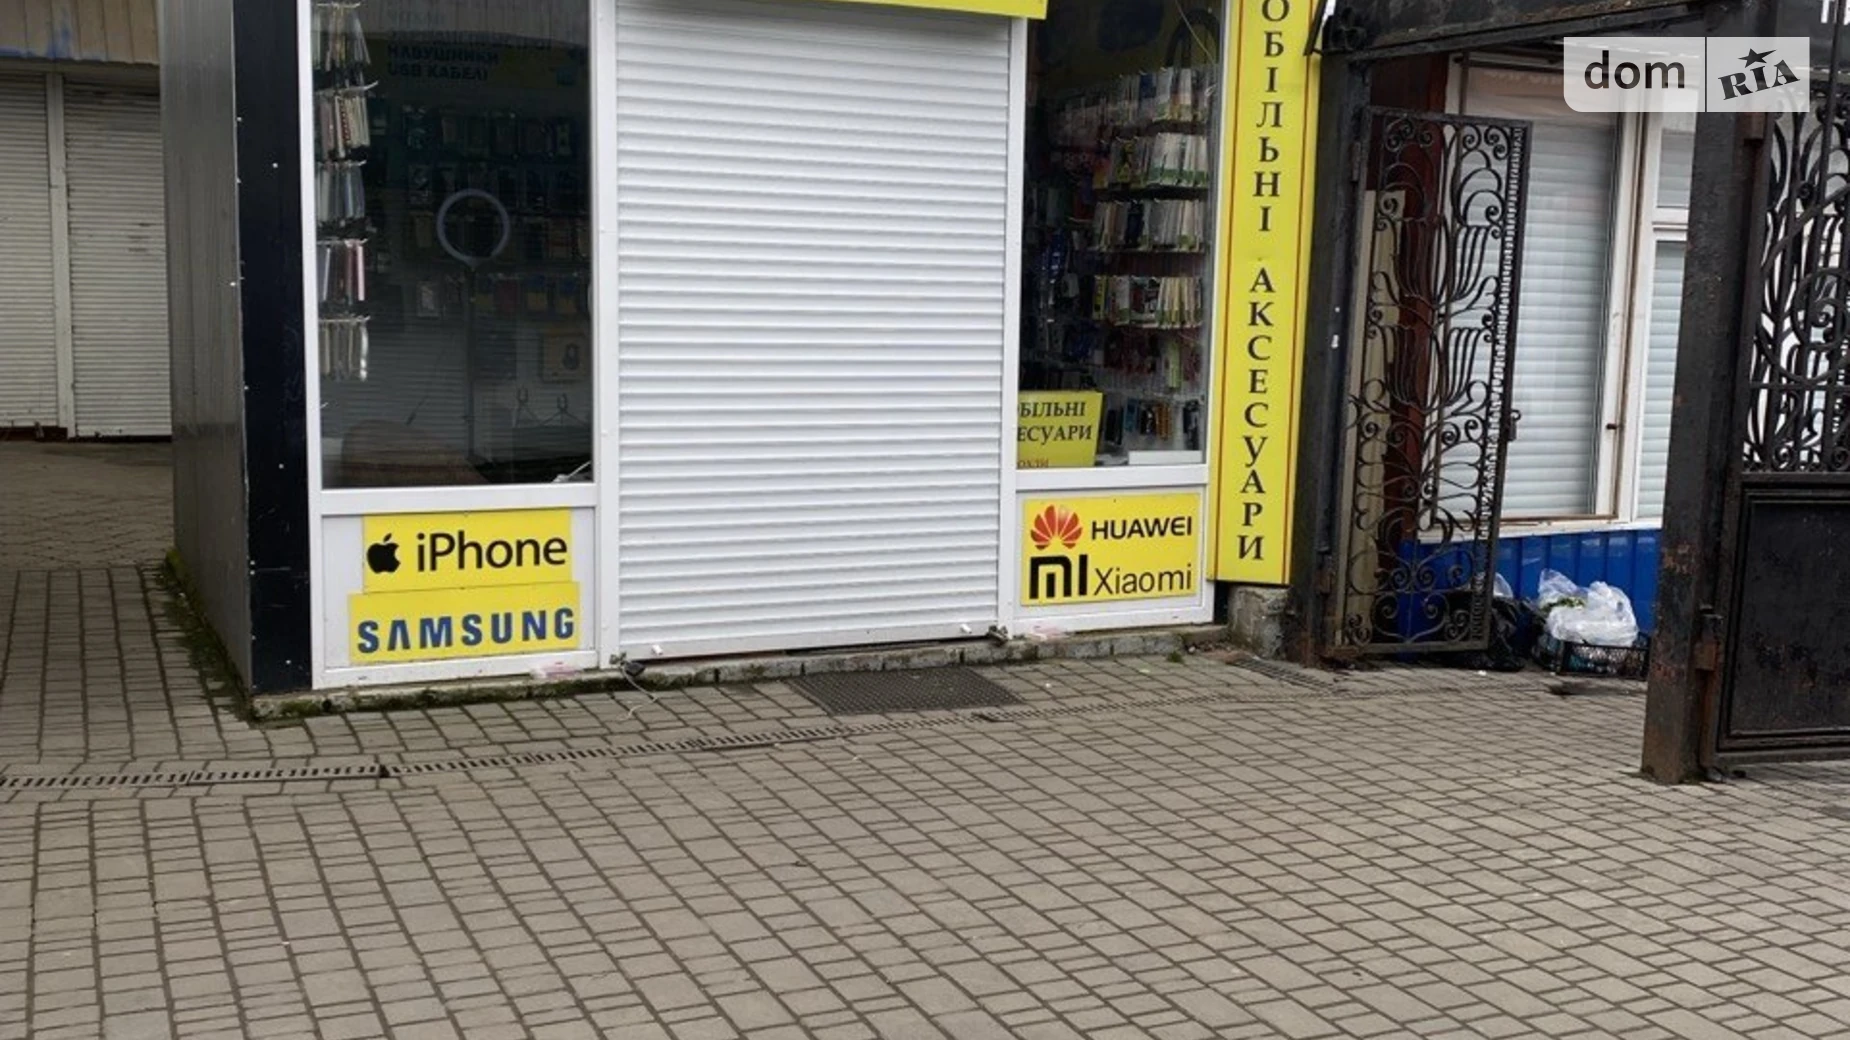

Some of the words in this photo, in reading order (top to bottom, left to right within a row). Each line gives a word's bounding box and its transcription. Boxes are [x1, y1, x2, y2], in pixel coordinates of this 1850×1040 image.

[1237, 268, 1275, 561] АКСЕСУАРИ
[1091, 516, 1192, 541] HUAWEI
[416, 530, 567, 572] iPhone
[1094, 563, 1192, 596] Xiaomi
[357, 607, 574, 653] SAMSUNG
